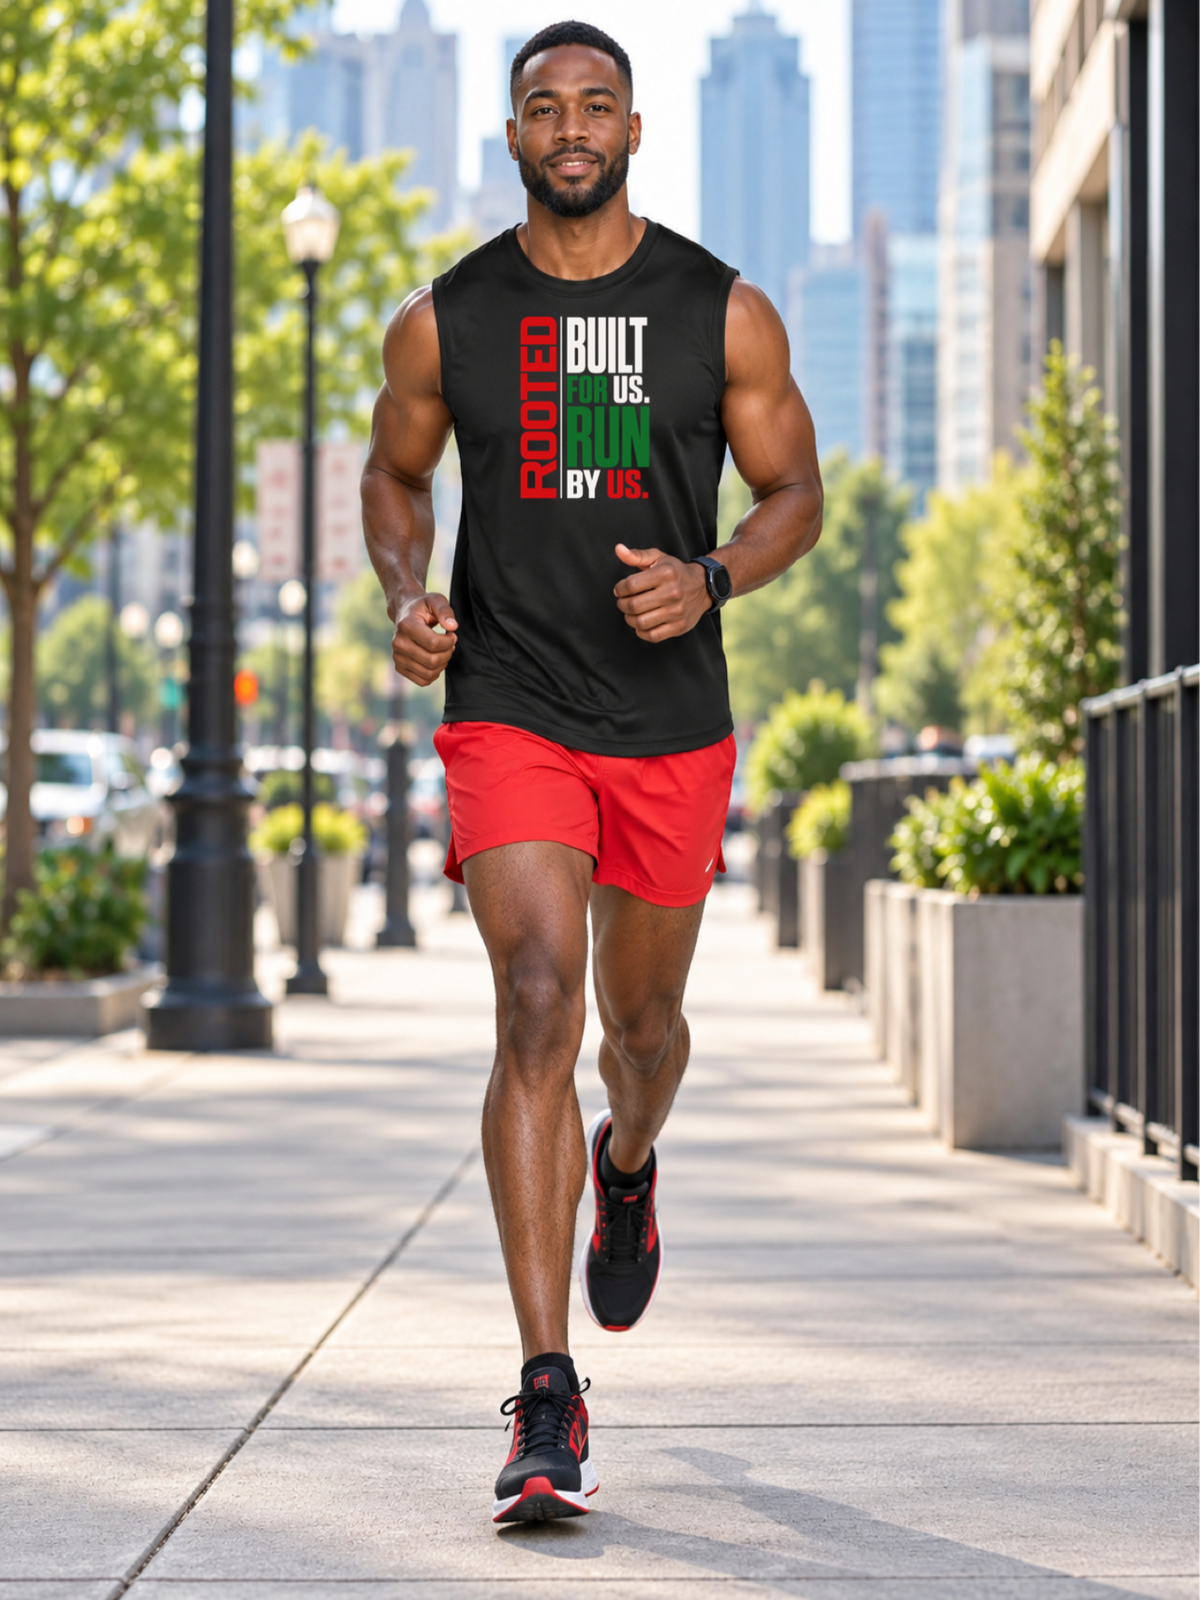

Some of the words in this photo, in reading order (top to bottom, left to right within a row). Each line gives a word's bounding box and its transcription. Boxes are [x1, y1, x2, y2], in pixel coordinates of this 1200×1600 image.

[567, 317, 648, 373] BUILT
[520, 316, 557, 499] ROOTED
[567, 375, 608, 403] FOR
[613, 375, 650, 404] US.
[567, 406, 650, 468] RUN
[567, 469, 600, 499] BY
[607, 469, 649, 499] US.
